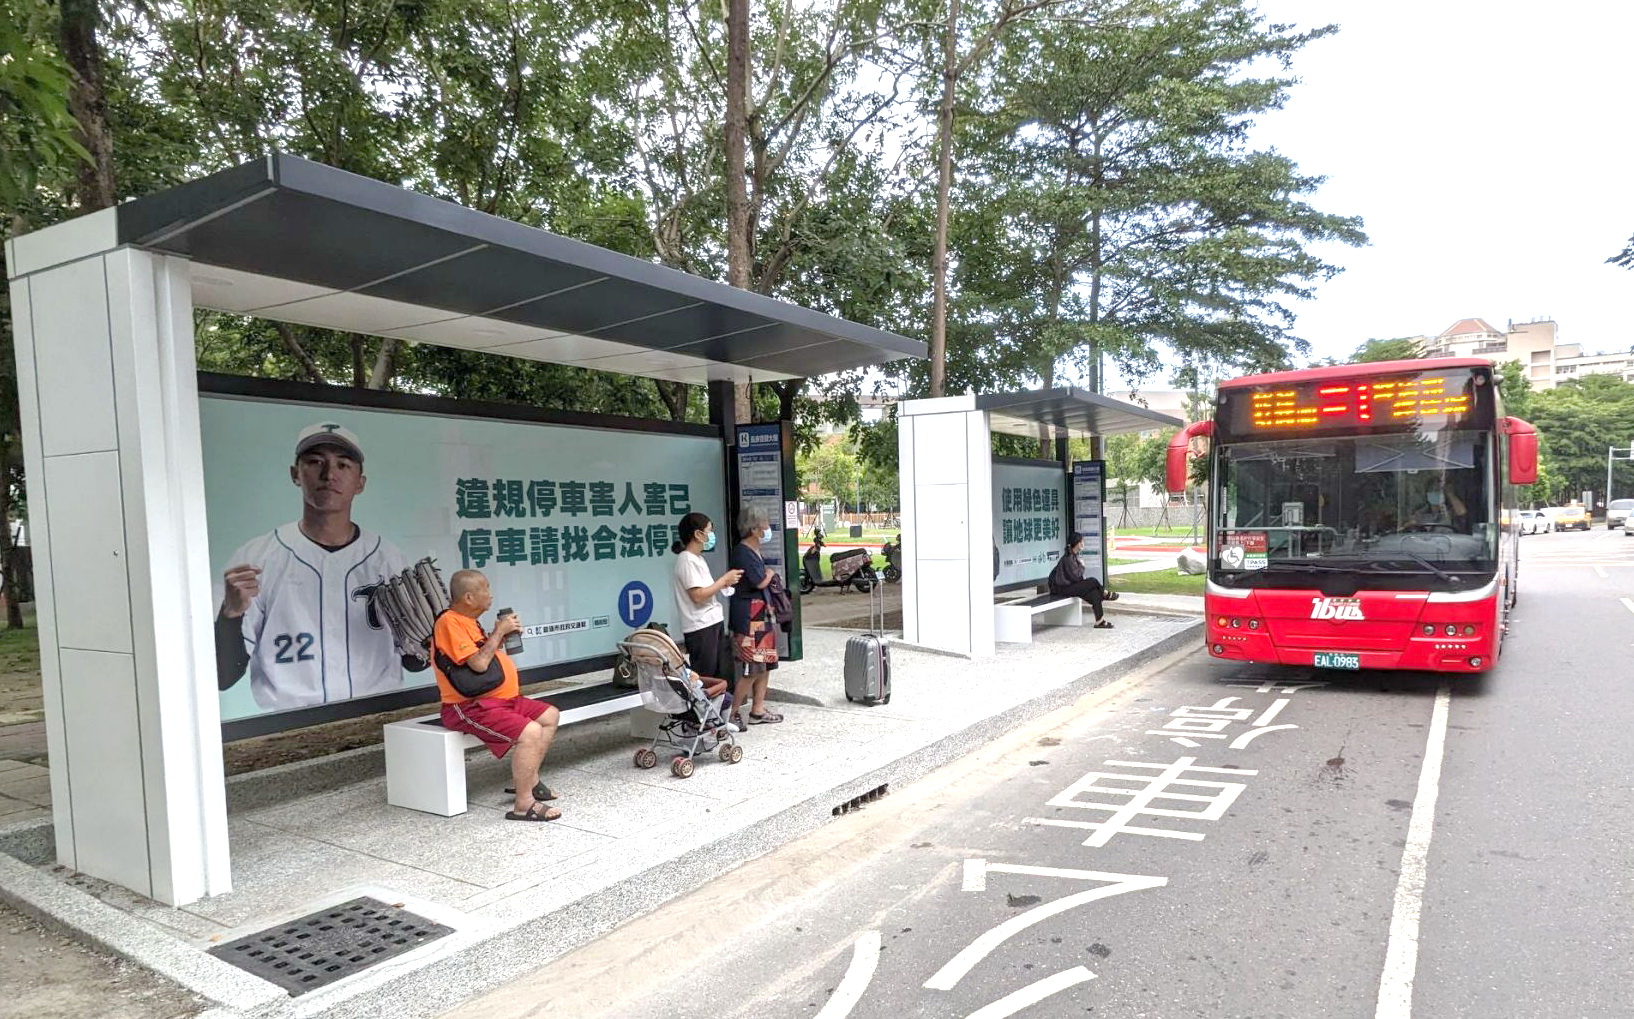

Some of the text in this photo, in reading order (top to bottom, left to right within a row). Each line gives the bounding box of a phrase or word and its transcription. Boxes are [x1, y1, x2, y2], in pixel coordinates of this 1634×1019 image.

[456, 478, 691, 519] 違規停車害人害己
[628, 589, 646, 620] P
[274, 633, 314, 663] 22
[1314, 654, 1359, 669] EAL-0983
